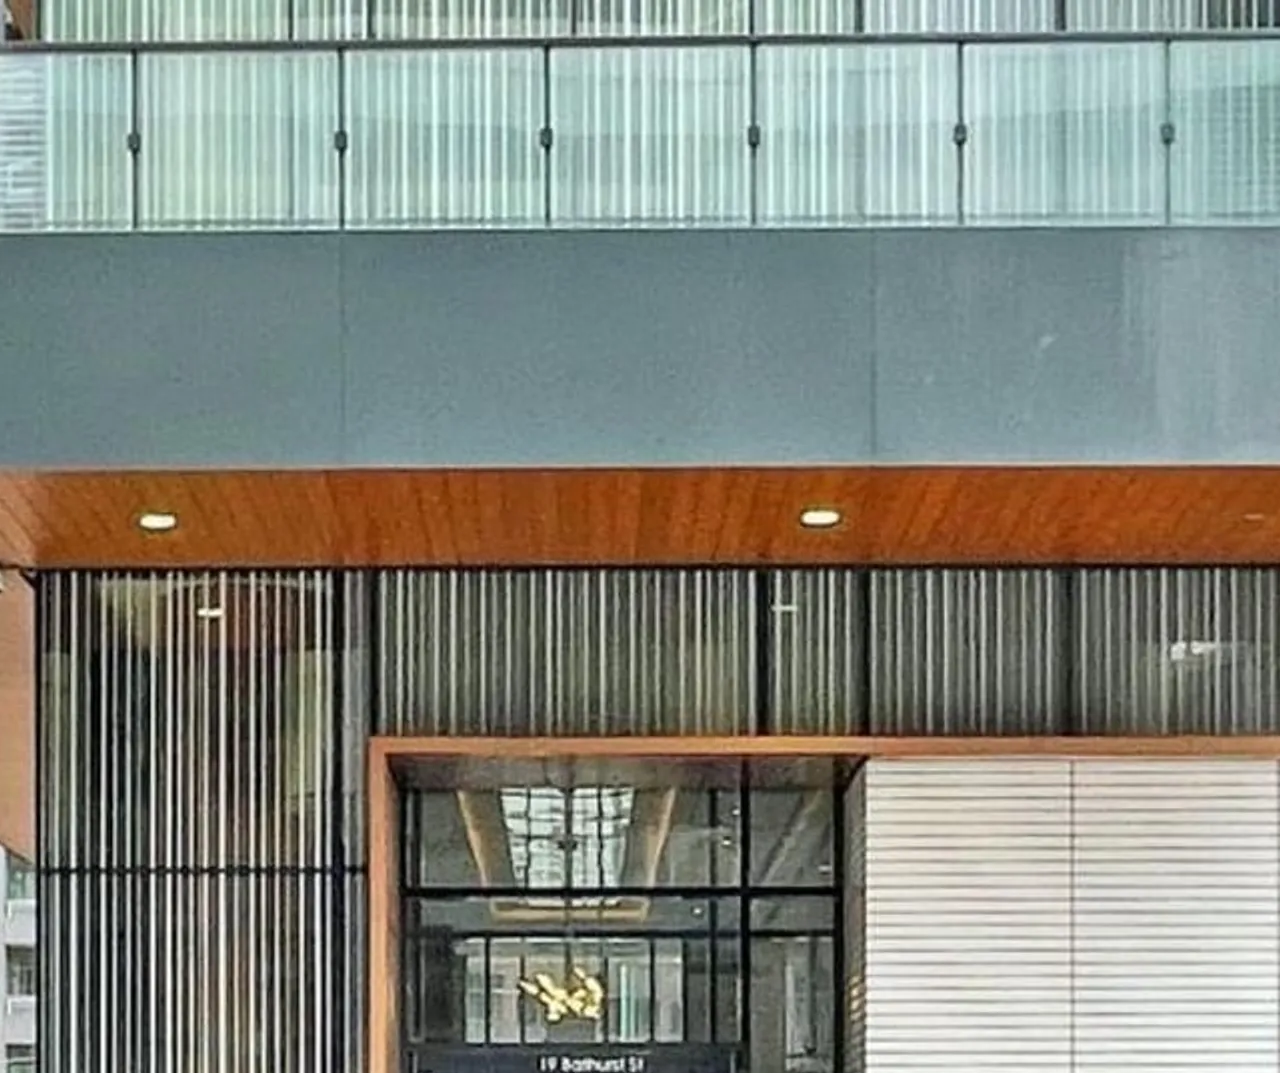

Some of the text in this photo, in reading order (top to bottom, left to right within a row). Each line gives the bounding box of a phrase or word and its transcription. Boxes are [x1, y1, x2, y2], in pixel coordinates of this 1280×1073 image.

[540, 1056, 644, 1073] 19 Bathurst St
